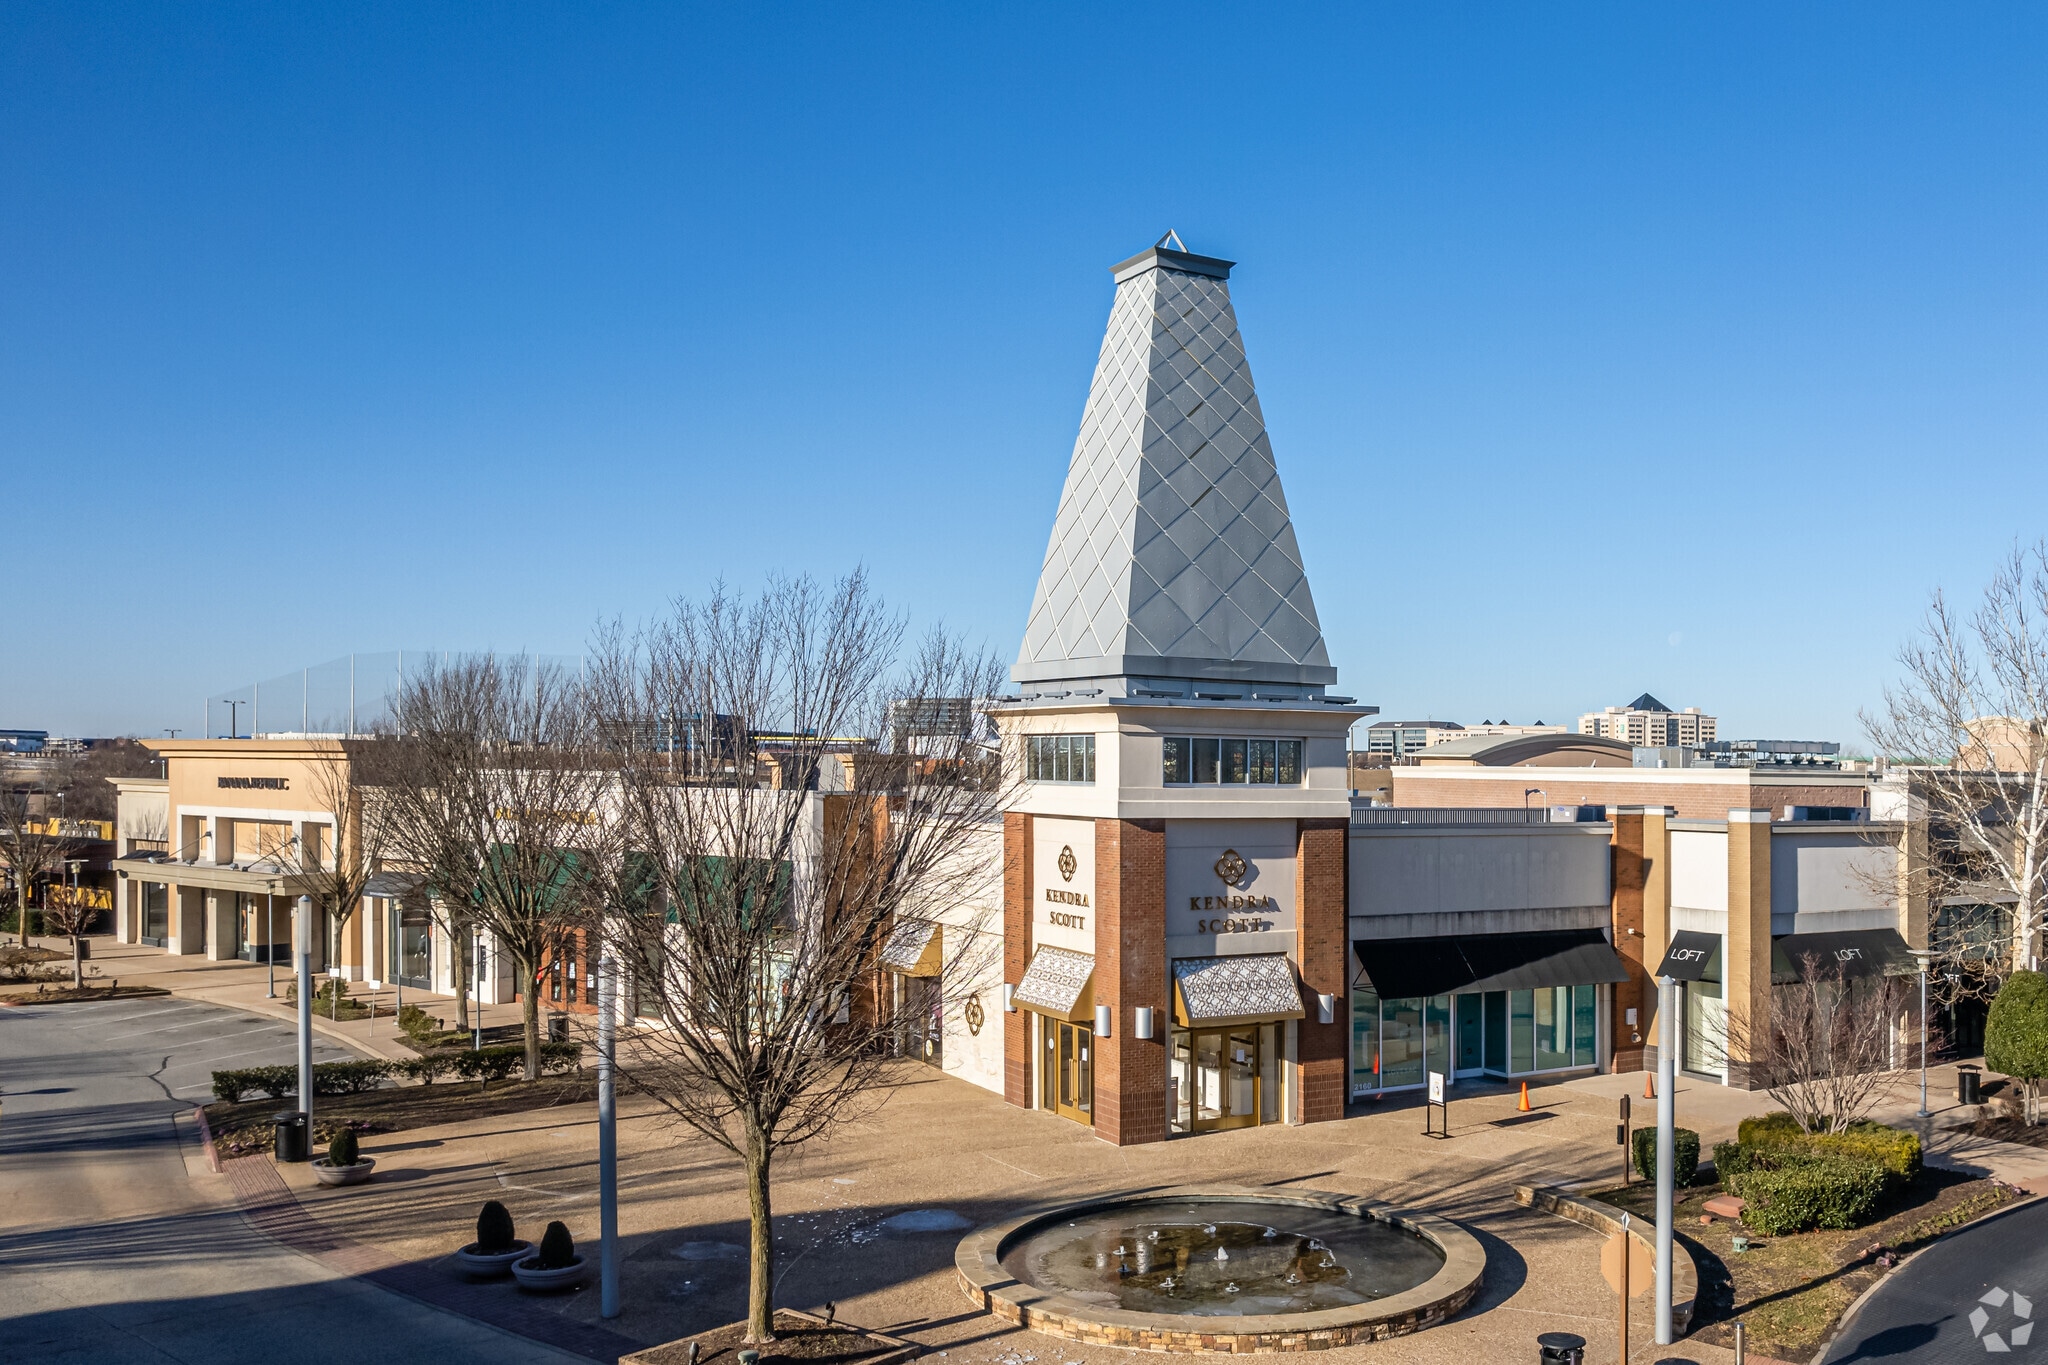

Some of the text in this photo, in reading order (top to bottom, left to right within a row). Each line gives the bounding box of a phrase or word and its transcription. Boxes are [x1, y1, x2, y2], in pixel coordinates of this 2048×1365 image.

[1046, 888, 1090, 907] KENDRA
[1189, 894, 1270, 911] KENDRA
[1050, 911, 1086, 930] SCOTT
[1198, 917, 1262, 934] SCOTT
[1670, 948, 1705, 962] LOFT
[1833, 948, 1863, 961] LOFT
[1354, 1082, 1372, 1090] 2160
